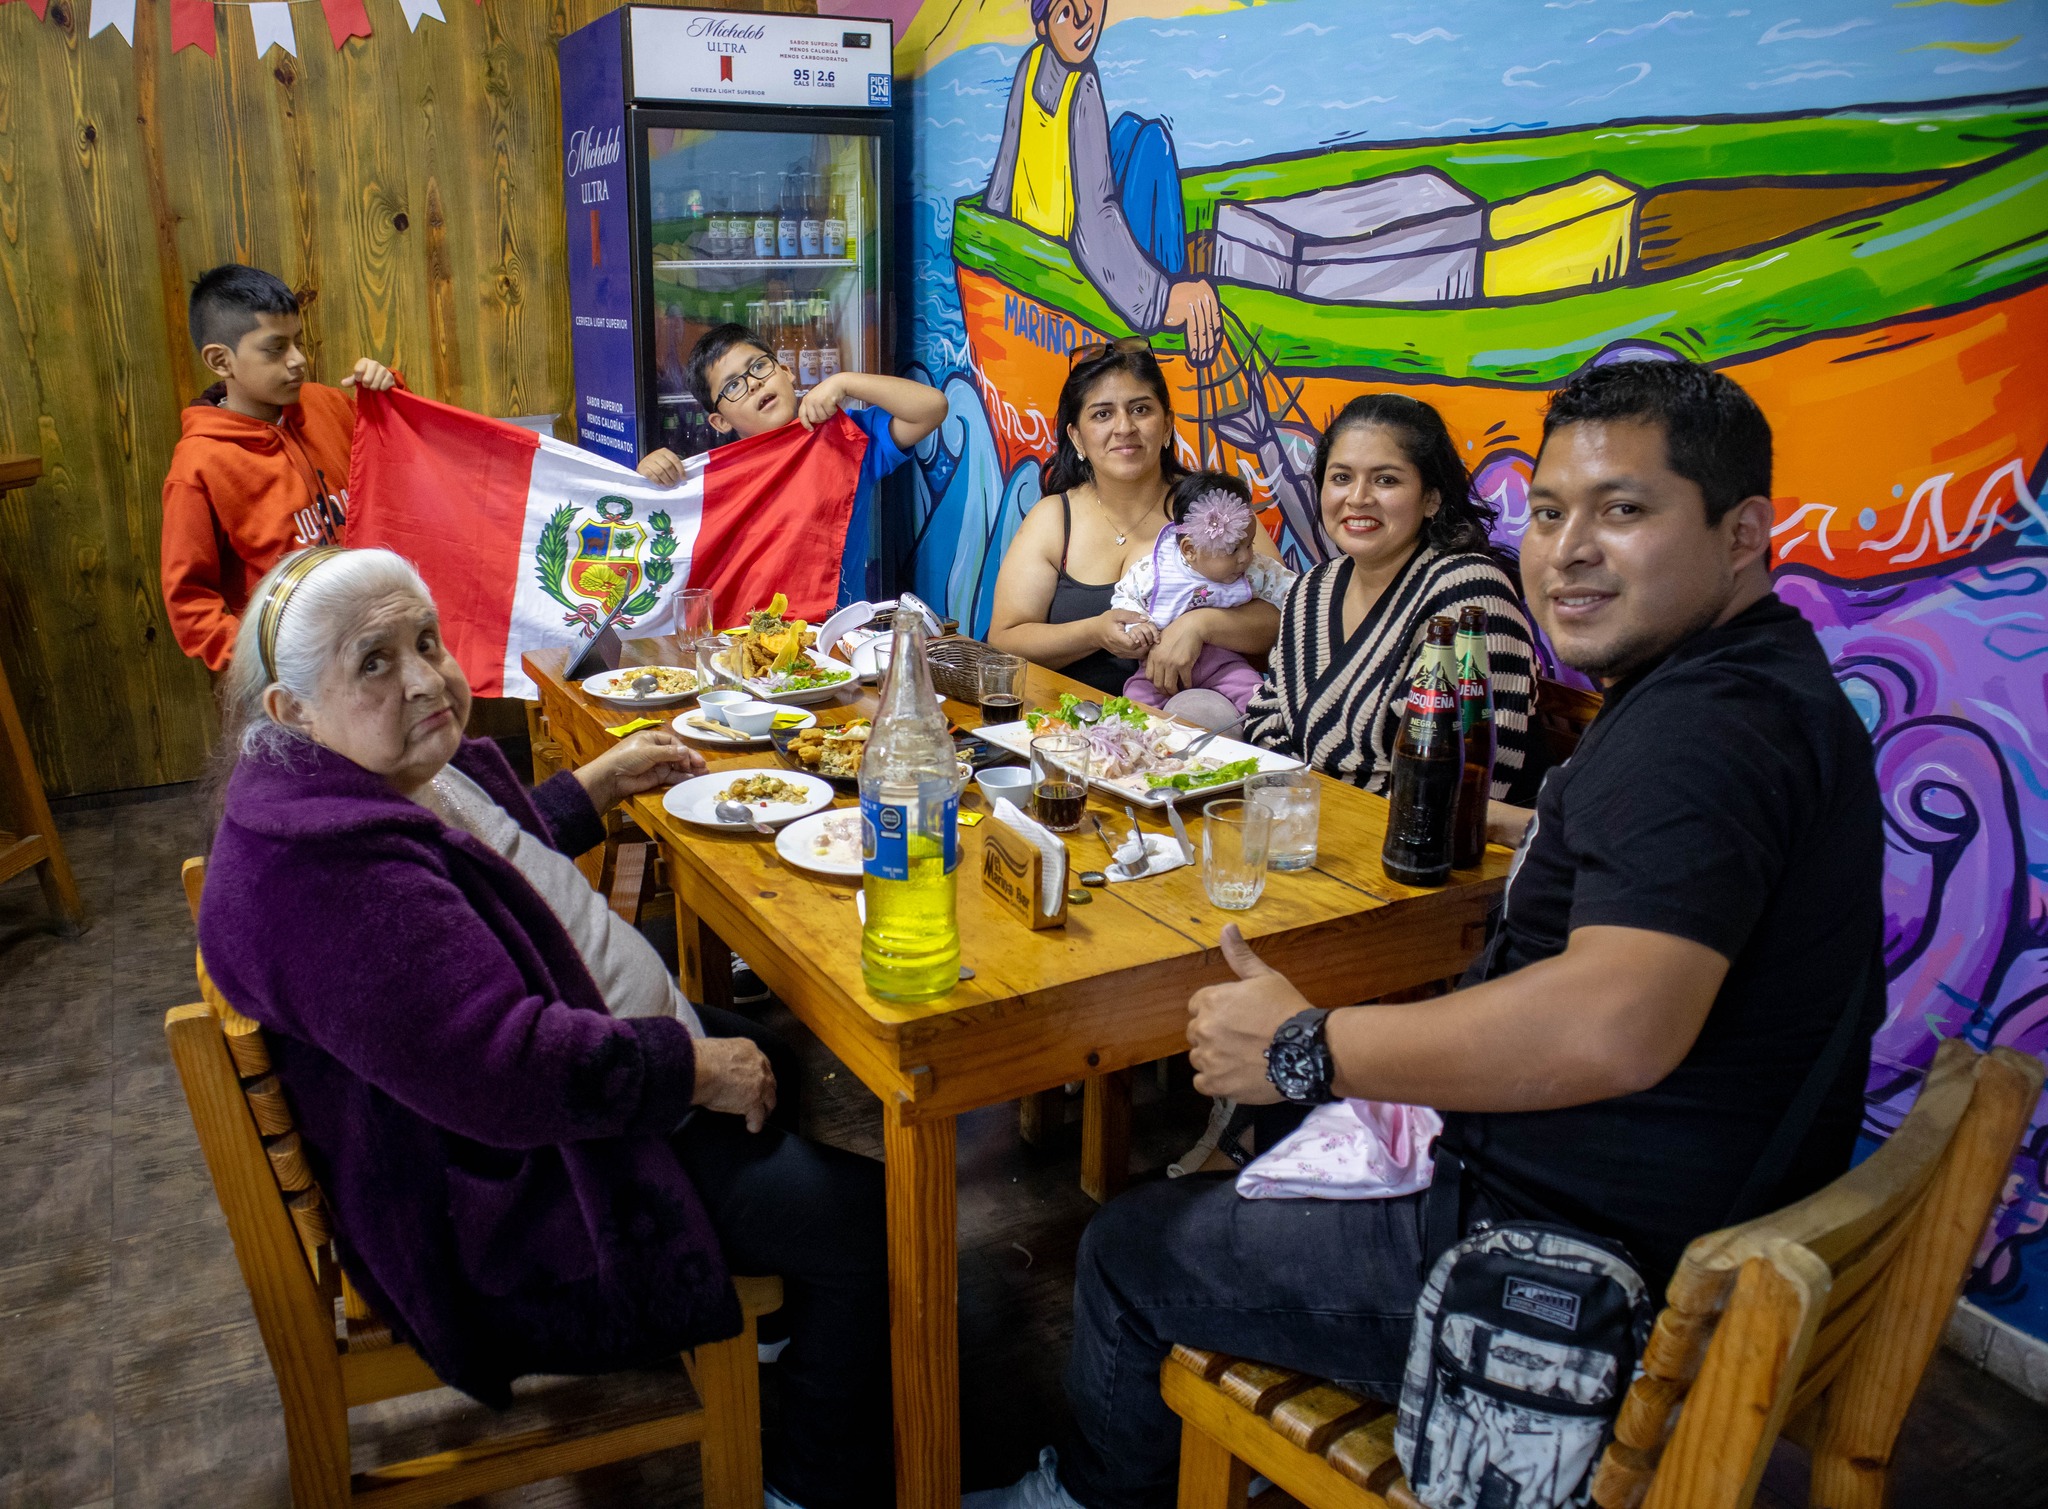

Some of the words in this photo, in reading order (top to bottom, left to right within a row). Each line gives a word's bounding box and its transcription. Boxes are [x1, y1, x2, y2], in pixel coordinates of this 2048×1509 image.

[686, 17, 765, 40] Michelob
[707, 42, 747, 53] ULTRA
[800, 54, 848, 62] CARBOHIDRATOS
[793, 69, 810, 80] 95
[817, 71, 835, 81] 2.6
[870, 76, 889, 86] PIDE
[870, 85, 889, 96] DNI
[567, 125, 620, 177] Michelob
[581, 179, 609, 204] ULTRA
[575, 316, 593, 326] CERVEZA
[593, 317, 605, 327] LIGHT
[606, 318, 628, 329] SUPERIOR
[586, 395, 600, 408] SABOR
[601, 399, 623, 413] SUPERIOR
[586, 413, 600, 426] MENOS
[581, 428, 595, 441] MENOS
[595, 432, 633, 453] CARBOHIDRATOS
[1410, 717, 1437, 729] NEGRA
